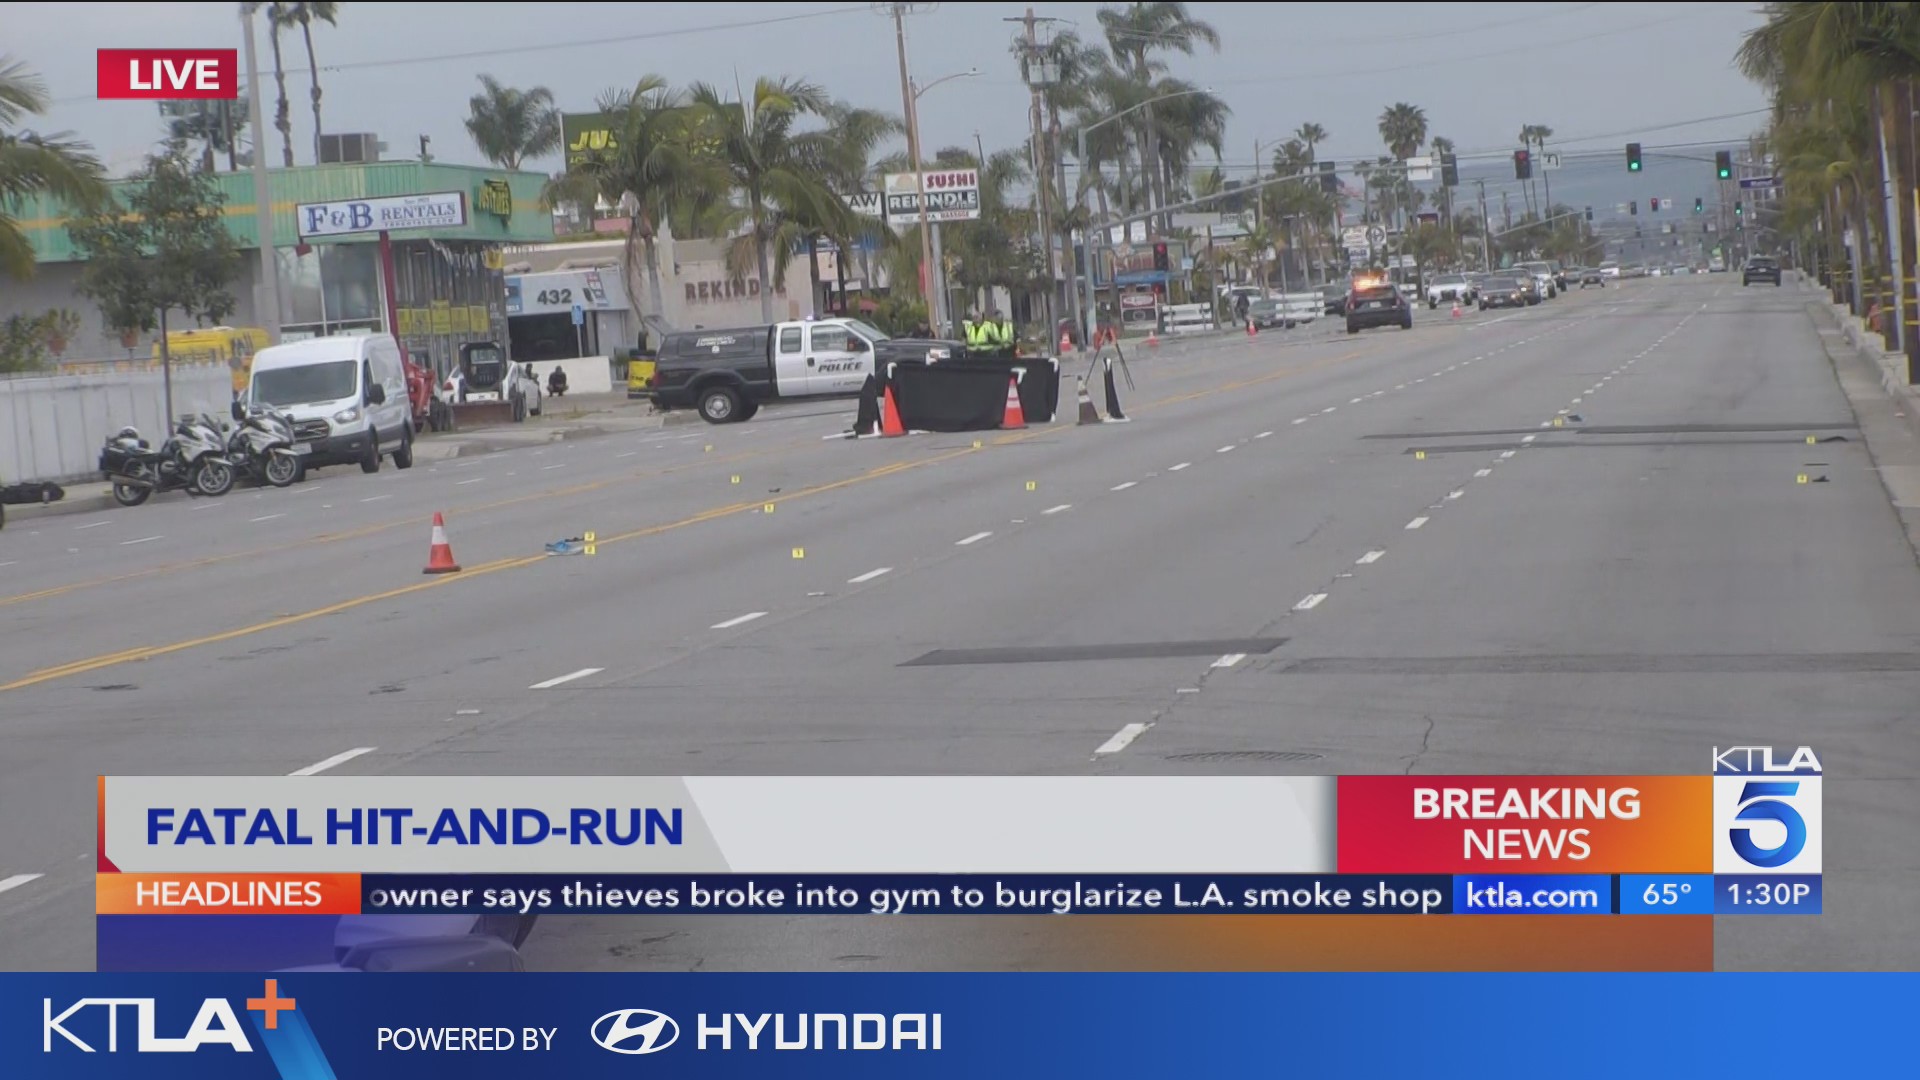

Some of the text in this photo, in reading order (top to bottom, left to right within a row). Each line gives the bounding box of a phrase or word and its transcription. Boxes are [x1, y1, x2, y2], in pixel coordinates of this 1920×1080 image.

[926, 172, 976, 189] SUSHI
[306, 203, 456, 233] F & B RENTALS
[537, 288, 572, 305] 432
[818, 361, 864, 373] POLICE
